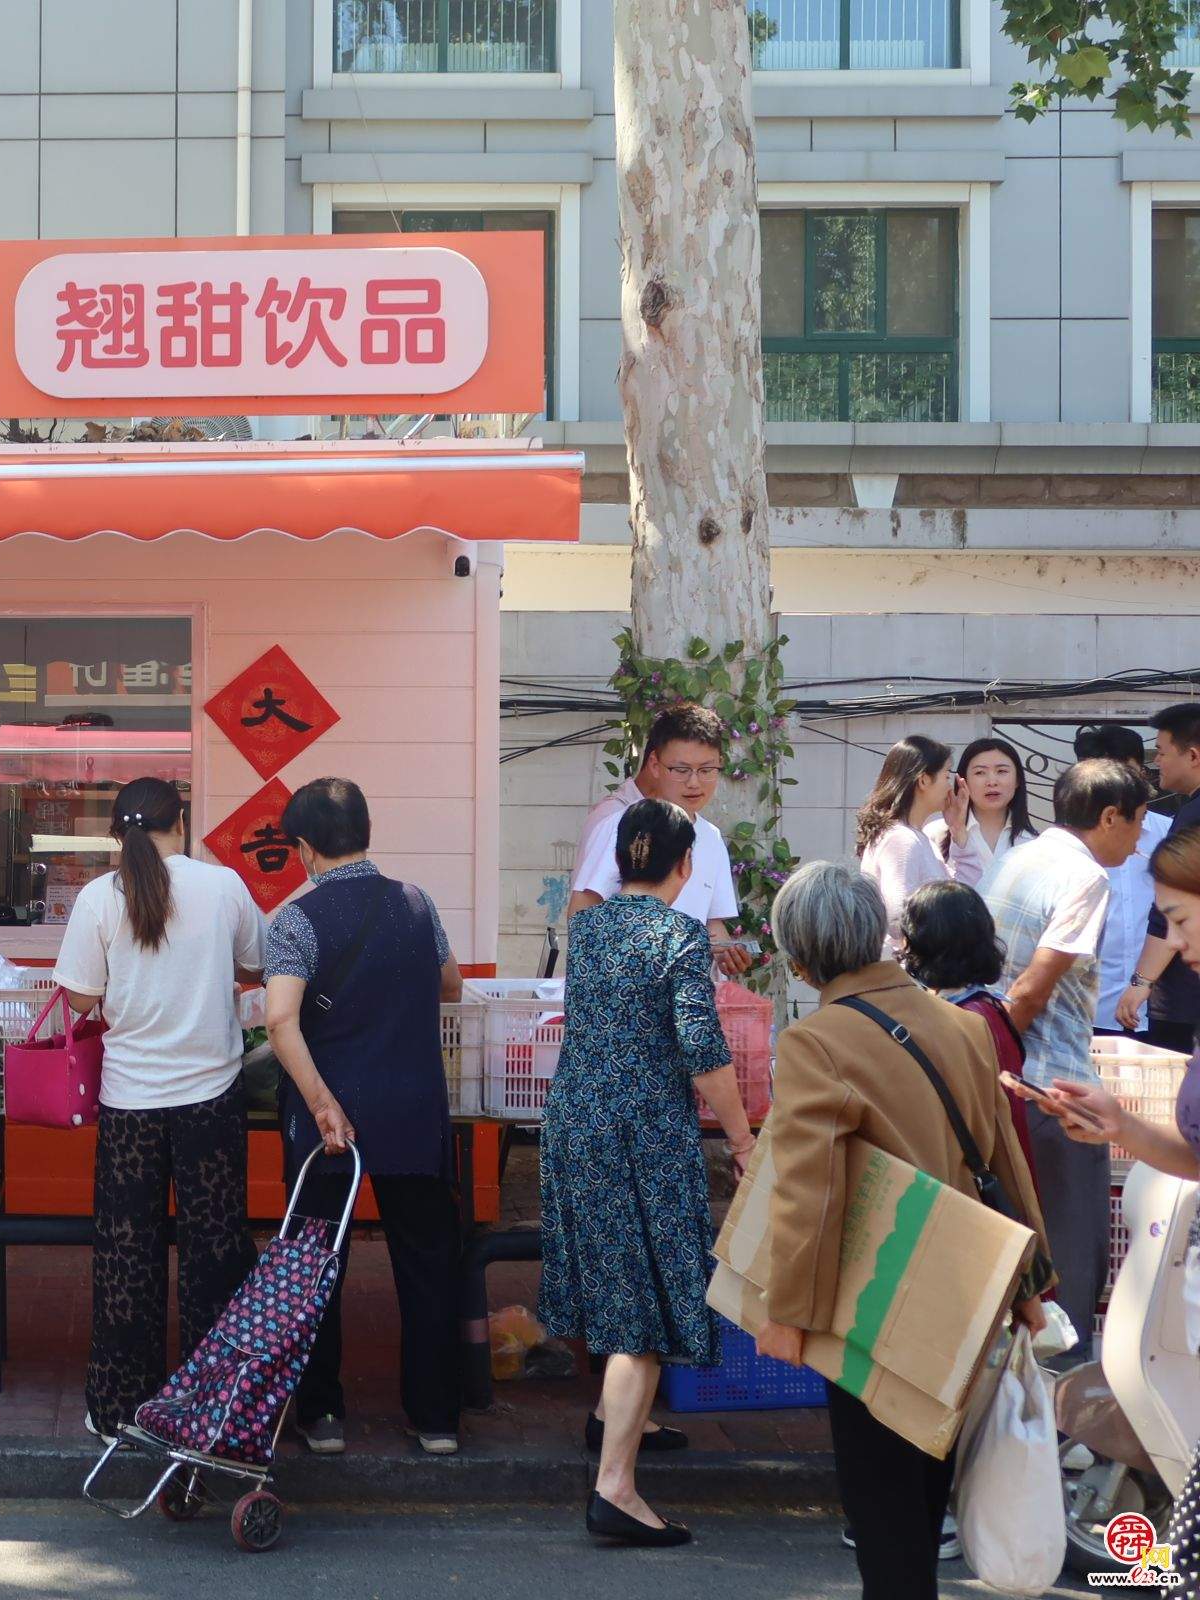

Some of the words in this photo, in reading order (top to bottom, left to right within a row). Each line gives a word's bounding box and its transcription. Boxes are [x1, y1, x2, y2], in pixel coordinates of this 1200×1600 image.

[56, 277, 446, 373] 翘甜饮品
[240, 687, 314, 732] 大
[240, 823, 300, 873] 吉
